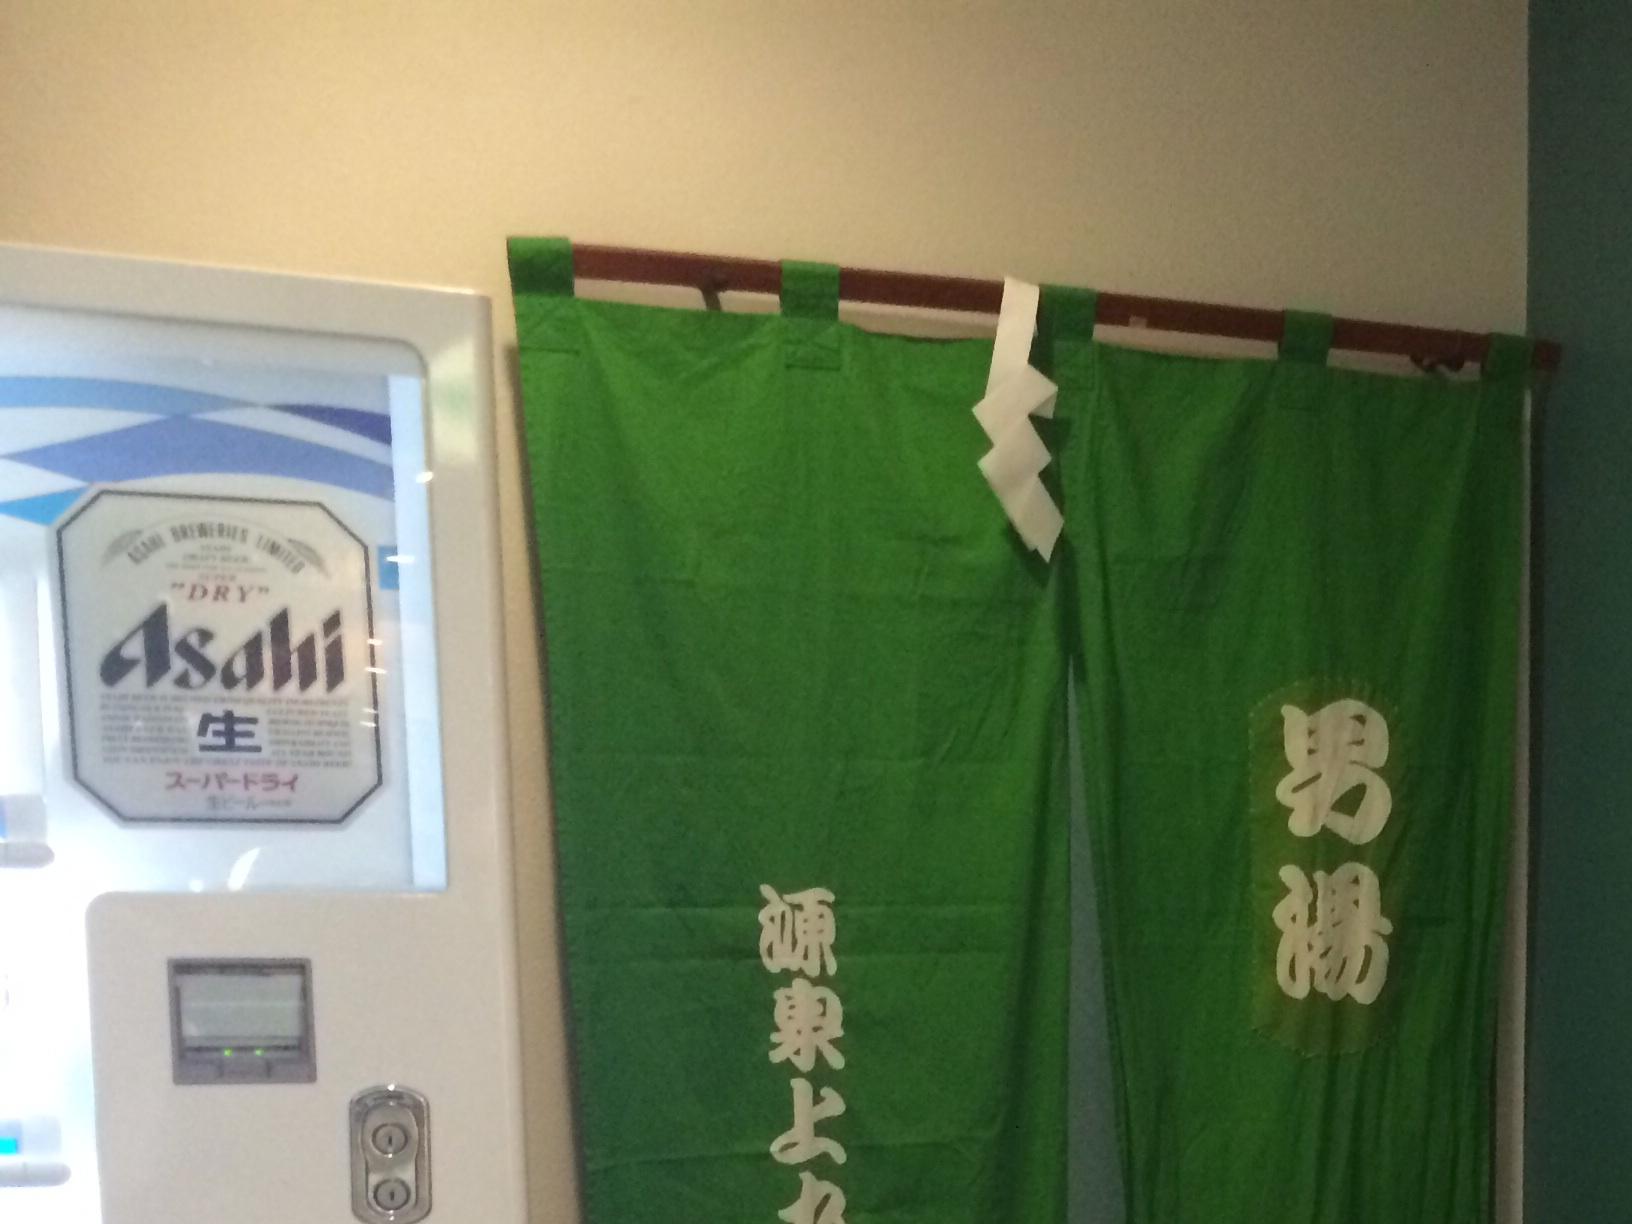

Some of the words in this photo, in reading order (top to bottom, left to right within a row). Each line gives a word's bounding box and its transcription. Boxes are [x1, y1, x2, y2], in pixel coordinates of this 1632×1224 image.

[98, 602, 346, 694] Asahi
[196, 709, 263, 753] 生
[165, 771, 300, 791] スーパードライ
[1276, 698, 1394, 1006] 男湯
